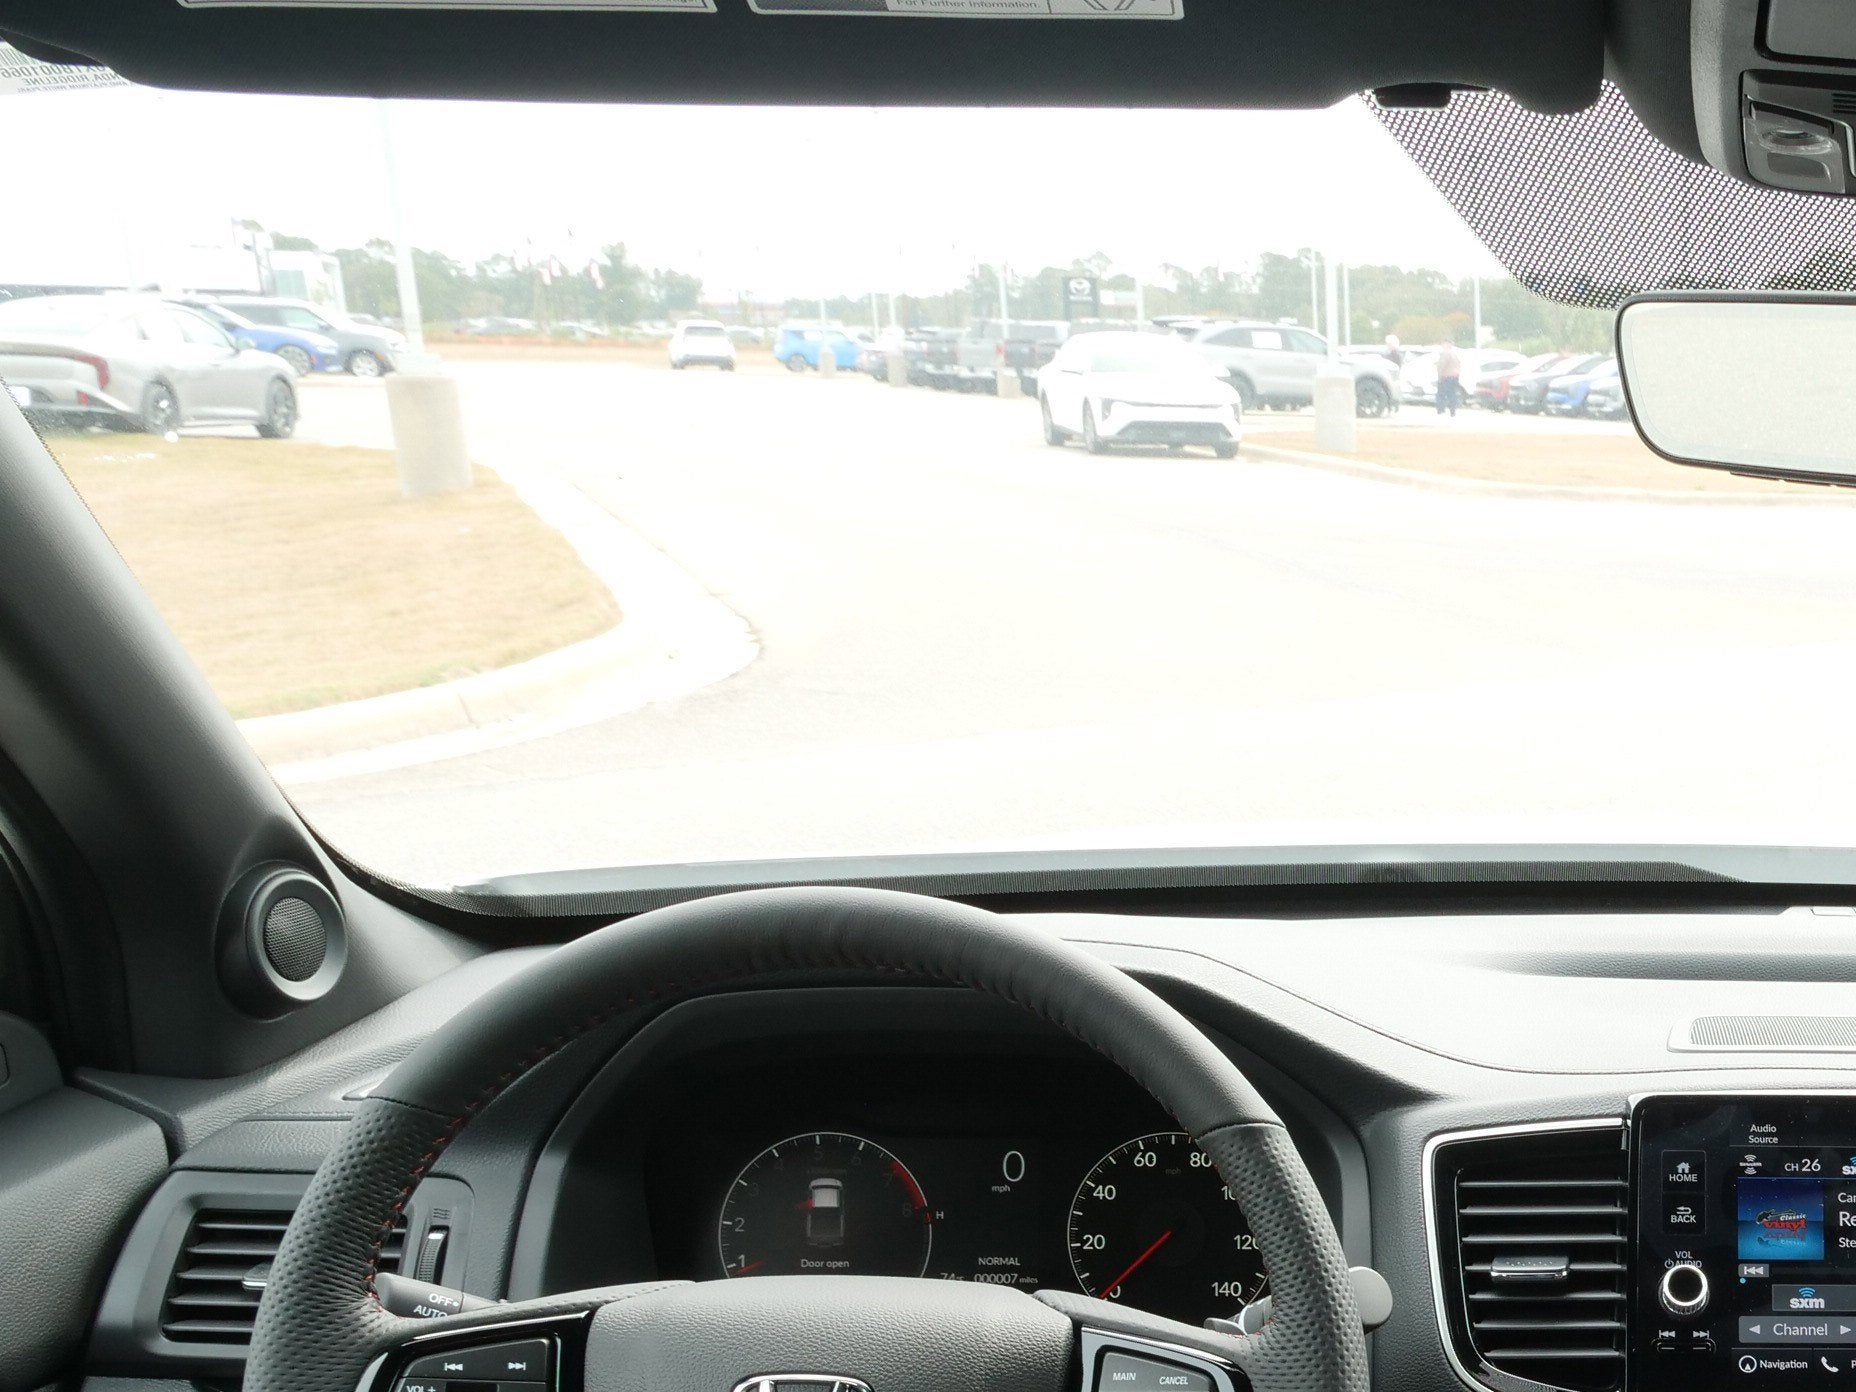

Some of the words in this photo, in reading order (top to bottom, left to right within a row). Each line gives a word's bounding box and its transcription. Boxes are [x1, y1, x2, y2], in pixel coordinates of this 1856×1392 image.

[1750, 1124, 1776, 1132] Audio
[1749, 1135, 1779, 1144] Source
[1134, 1152, 1156, 1167] 60
[1190, 1152, 1212, 1168] 80
[1784, 1163, 1799, 1172] CH
[1801, 1159, 1821, 1172] 26
[1002, 1151, 1026, 1181] 0
[1669, 1174, 1698, 1182] HOME
[991, 1184, 1011, 1193] mph
[1093, 1185, 1116, 1200] 40
[734, 1218, 745, 1232] 2
[1671, 1215, 1696, 1223] BACK
[1083, 1235, 1105, 1249] 20
[738, 1255, 746, 1268] 1
[801, 1259, 825, 1268] Door
[827, 1260, 850, 1270] open
[979, 1257, 1020, 1265] NORMAL
[1212, 1282, 1242, 1297] 140
[429, 1293, 452, 1305] OFF
[1789, 1297, 1825, 1309] sxm
[1773, 1323, 1828, 1336] Channel
[1759, 1360, 1808, 1370] Navigation
[1112, 1372, 1136, 1381] MAIN
[1159, 1376, 1189, 1385] CANCEL
